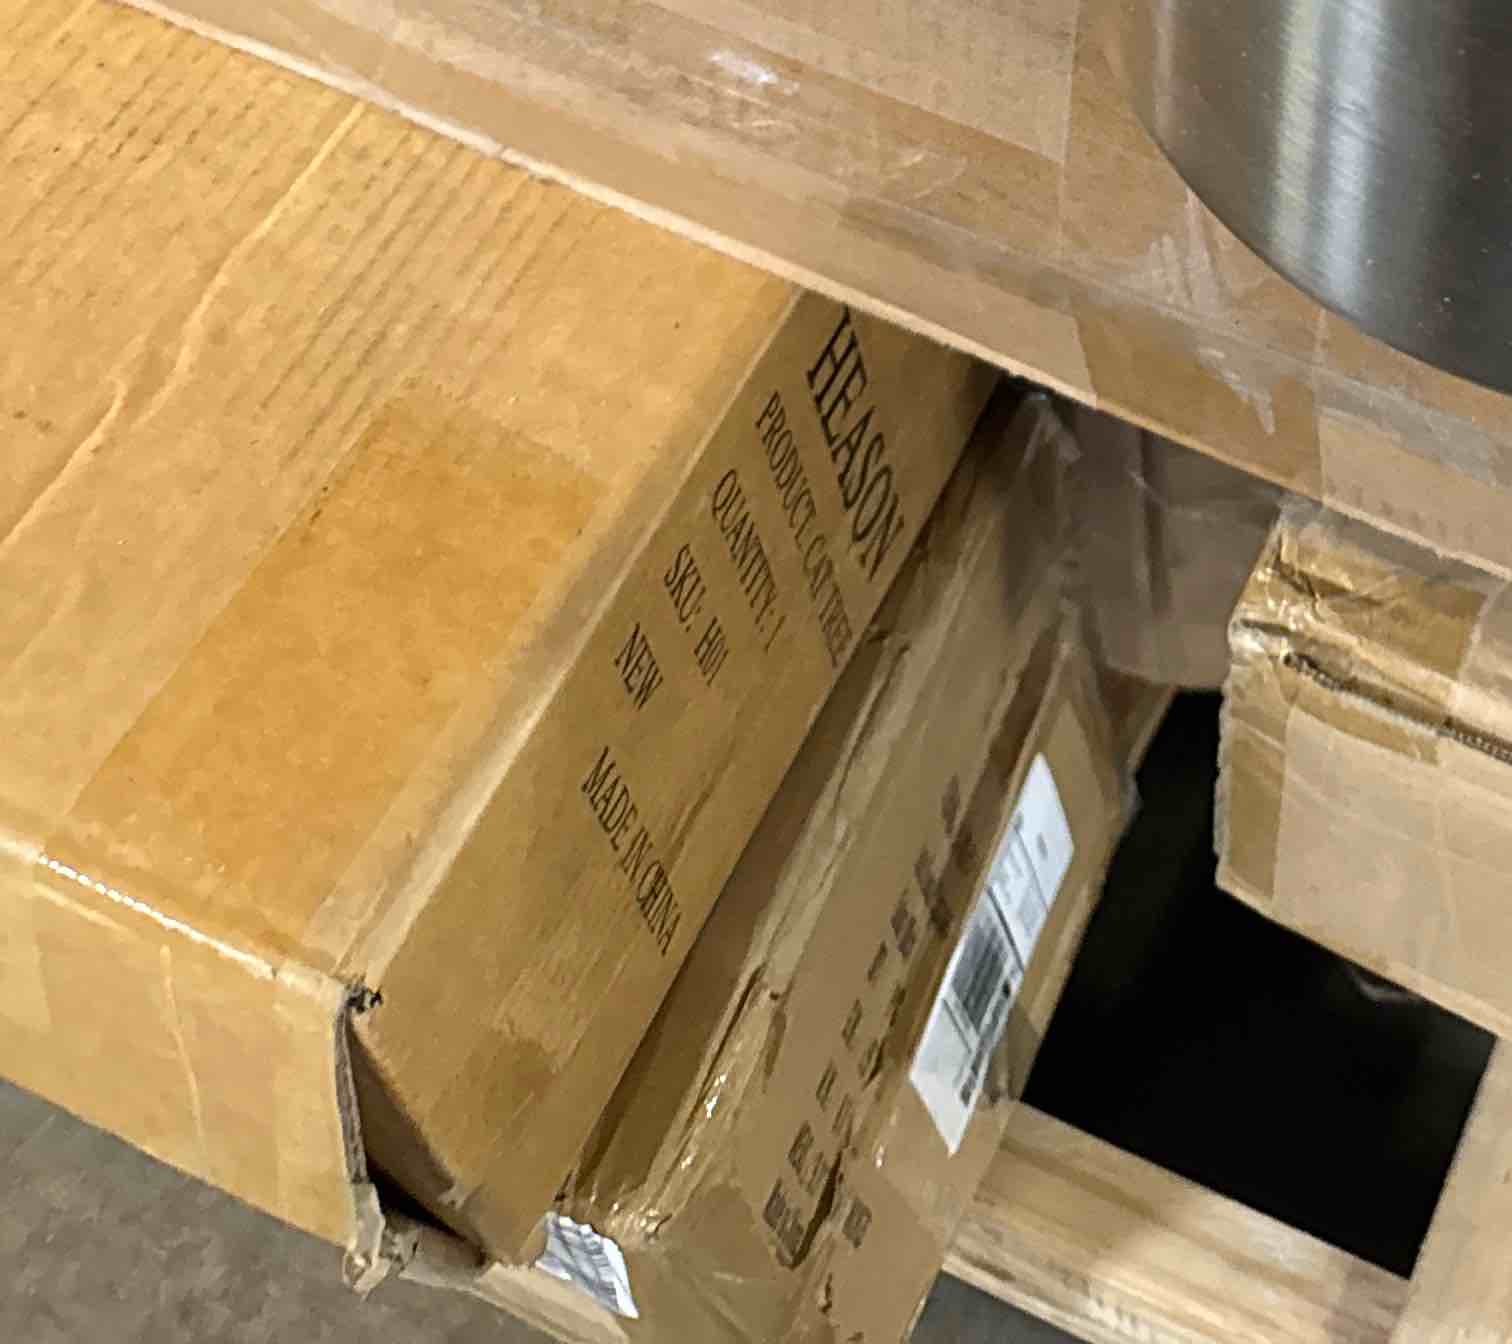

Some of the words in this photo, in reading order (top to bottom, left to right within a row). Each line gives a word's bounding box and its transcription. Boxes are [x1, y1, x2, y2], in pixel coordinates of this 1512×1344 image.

[806, 304, 905, 584] HEASON
[663, 542, 707, 633] SKU:
[613, 621, 664, 711] NEW
[580, 745, 640, 852] MADE
[621, 825, 654, 882] IN
[635, 859, 682, 958] CHINA
